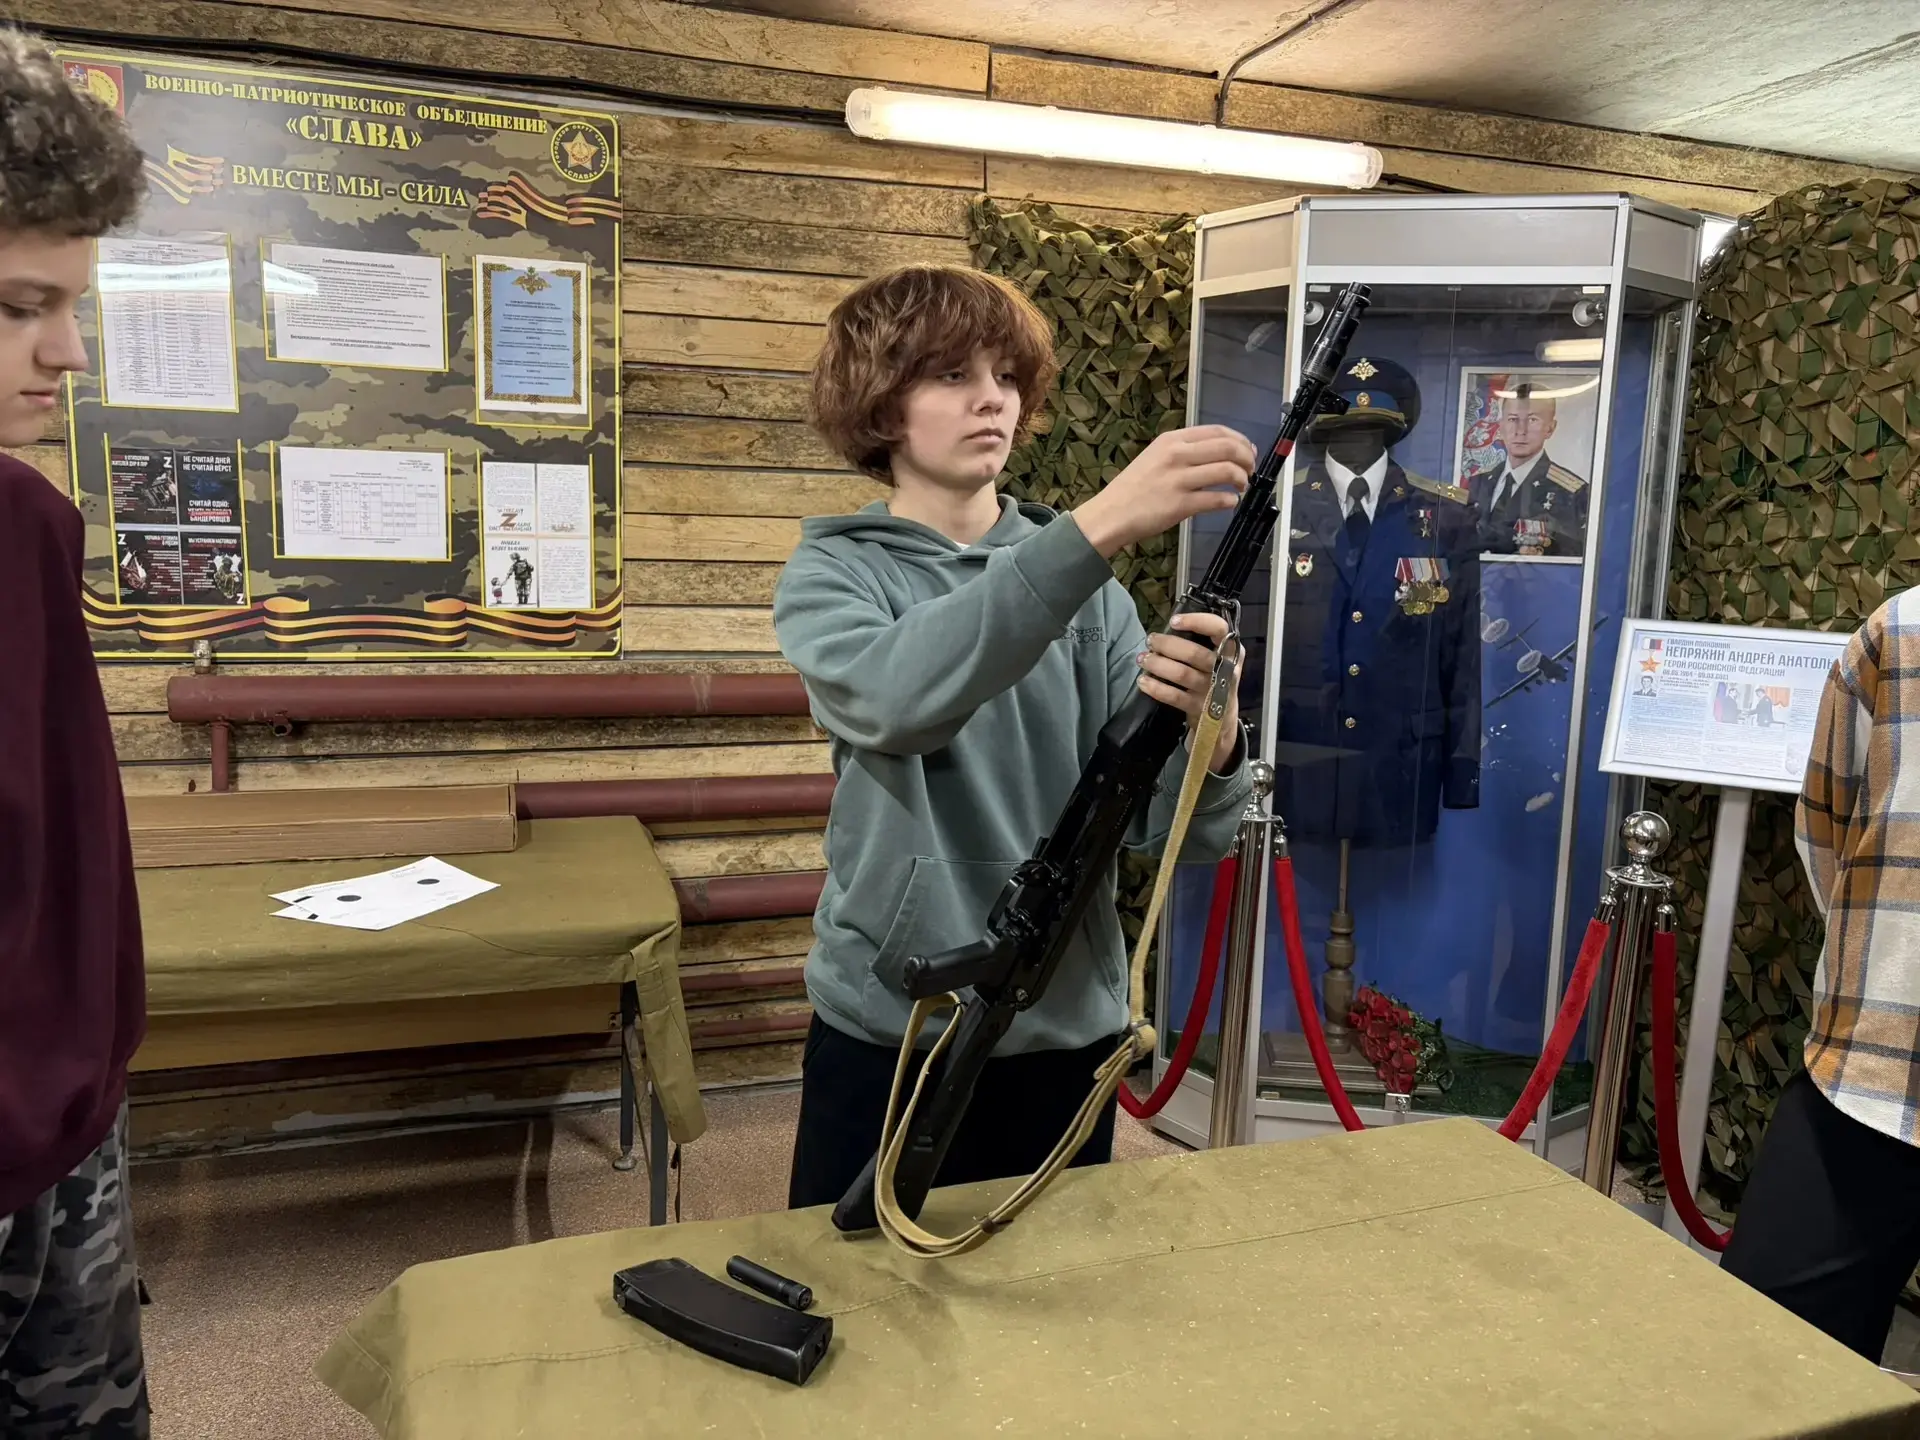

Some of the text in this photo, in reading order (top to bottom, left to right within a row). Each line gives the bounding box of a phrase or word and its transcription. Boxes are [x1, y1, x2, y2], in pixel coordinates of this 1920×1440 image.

[145, 74, 548, 134] ВОЕННО-ПАТРИОТИЧЕСКОЕ ОБЪЕДИНЕНИЕ
[285, 115, 423, 150] «СЛАВА»
[232, 164, 332, 195] ВМЕСТЕ
[335, 175, 381, 198] МЫ
[401, 182, 469, 208] СИЛА
[163, 456, 173, 468] Z
[183, 455, 231, 465] НЕ СЧИТАЙ ДНЕЙ
[183, 463, 191, 471] НЕ
[191, 464, 214, 472] СЧИТАЙ
[117, 533, 127, 545] Z
[236, 593, 245, 604] Z
[1665, 646, 1725, 661] НЕПРЯХИН
[1728, 651, 1775, 665] АНДРЕЙ
